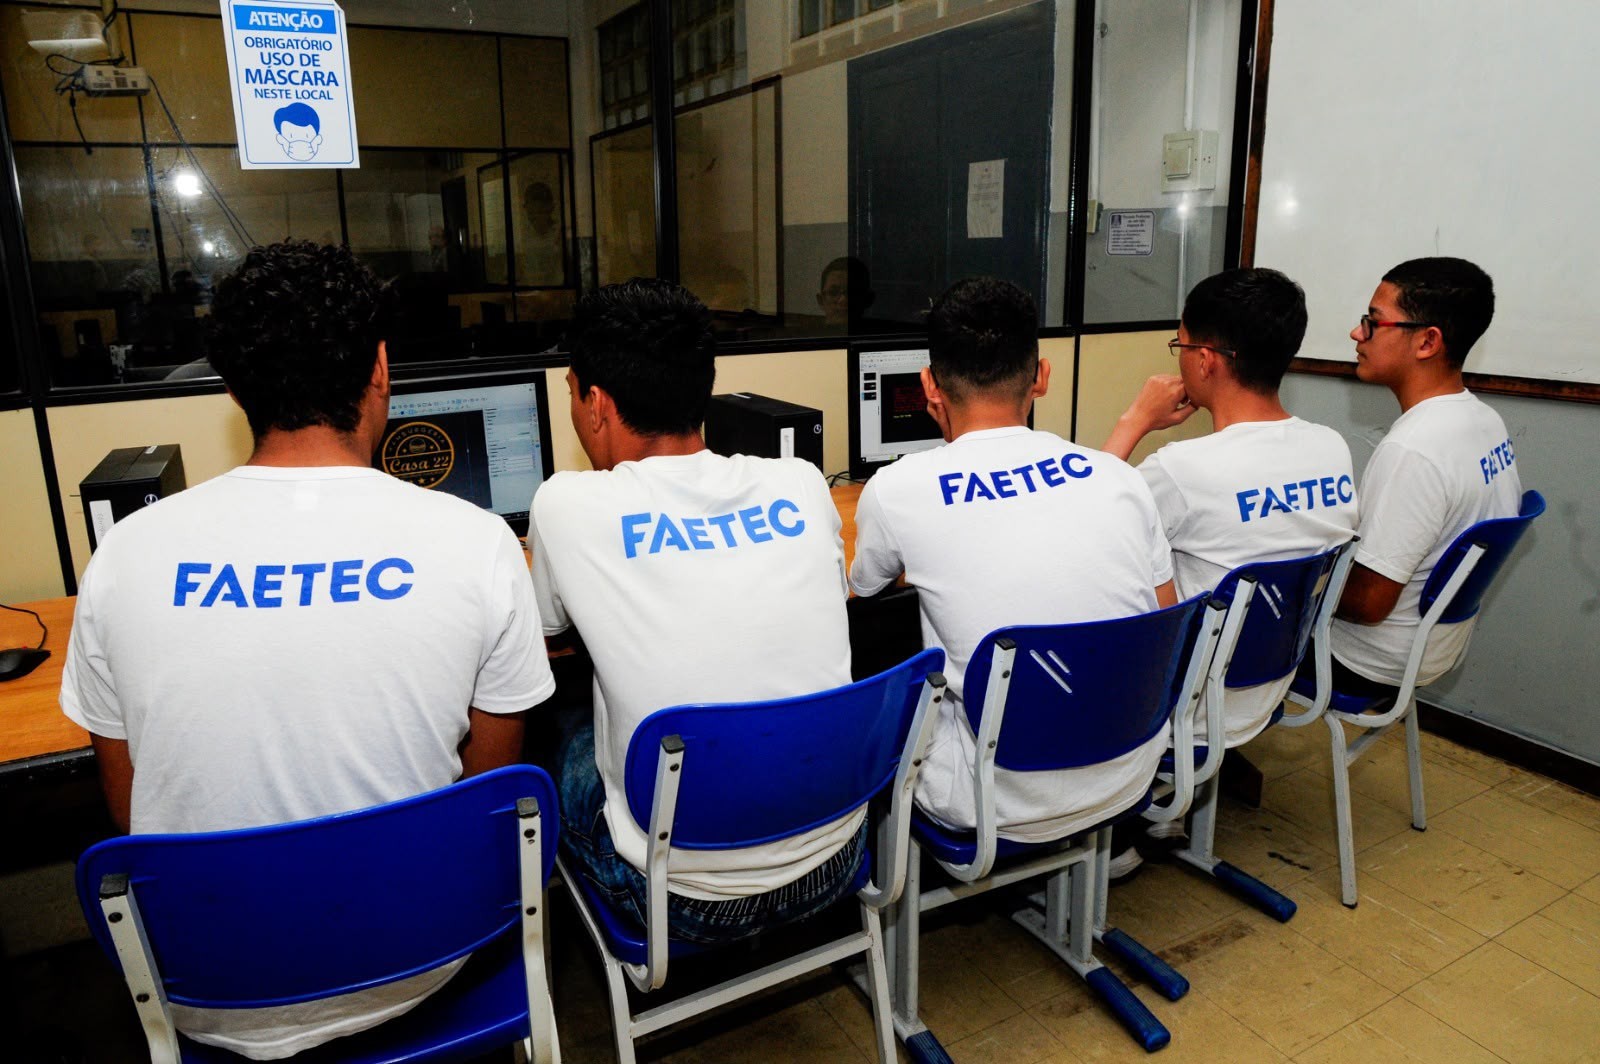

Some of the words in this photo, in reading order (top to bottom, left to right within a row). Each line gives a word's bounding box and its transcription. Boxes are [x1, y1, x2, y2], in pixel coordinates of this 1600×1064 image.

[248, 10, 324, 32] ATENÇÃO
[244, 36, 333, 51] OBRIGATÓRIO
[260, 51, 295, 67] USO
[299, 53, 321, 67] DE
[245, 66, 339, 87] MÁSCARA
[254, 88, 292, 99] NESTE
[295, 89, 334, 100] LOCAL
[389, 459, 430, 473] Casa
[433, 455, 450, 468] 22
[938, 453, 1093, 506] FAETEC
[1236, 474, 1353, 523] FAETEC
[621, 498, 806, 559] FAETEC
[173, 557, 415, 608] FAETEC
